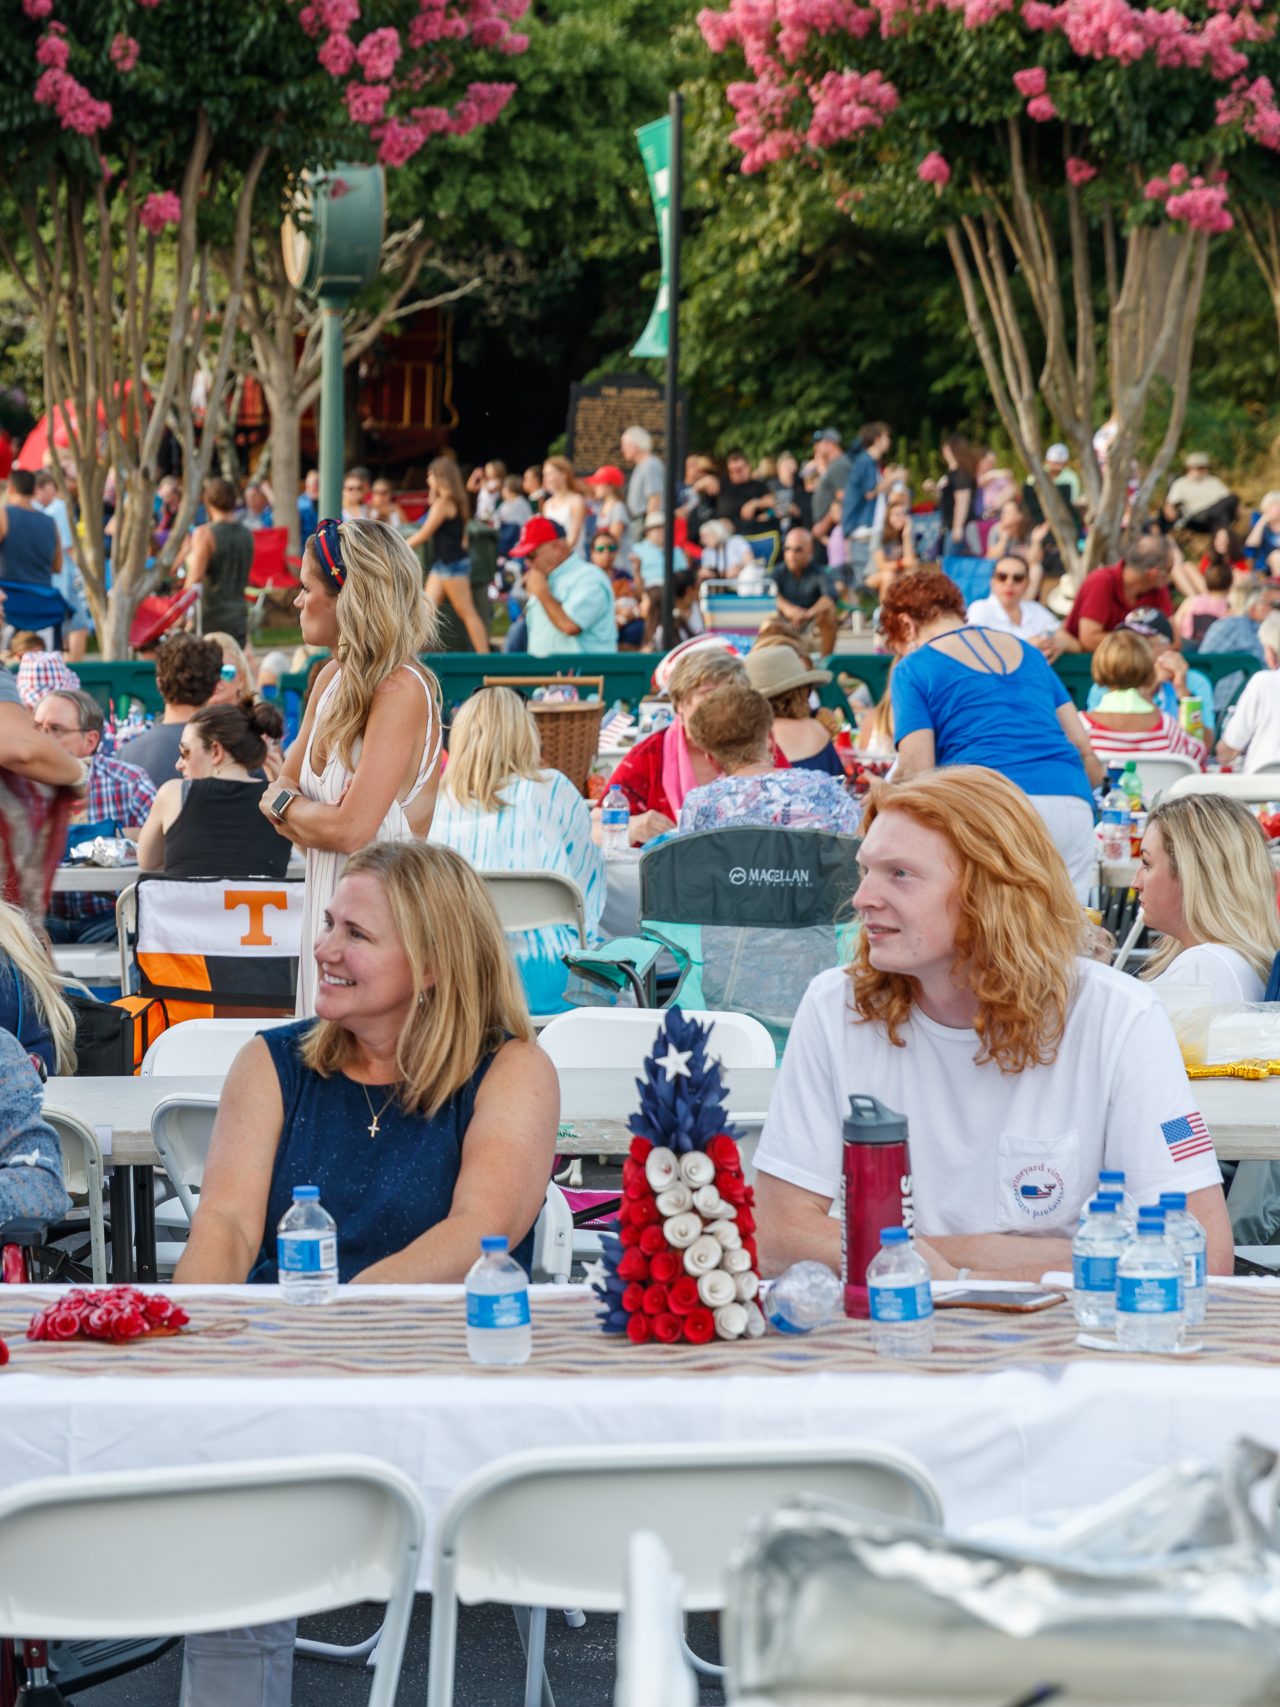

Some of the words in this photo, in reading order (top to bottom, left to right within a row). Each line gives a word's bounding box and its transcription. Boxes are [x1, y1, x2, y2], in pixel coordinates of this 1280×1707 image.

[748, 867, 810, 882] MAGELLAN
[223, 889, 289, 946] T
[1012, 1162, 1045, 1189] vineyard
[1047, 1167, 1065, 1187] vines
